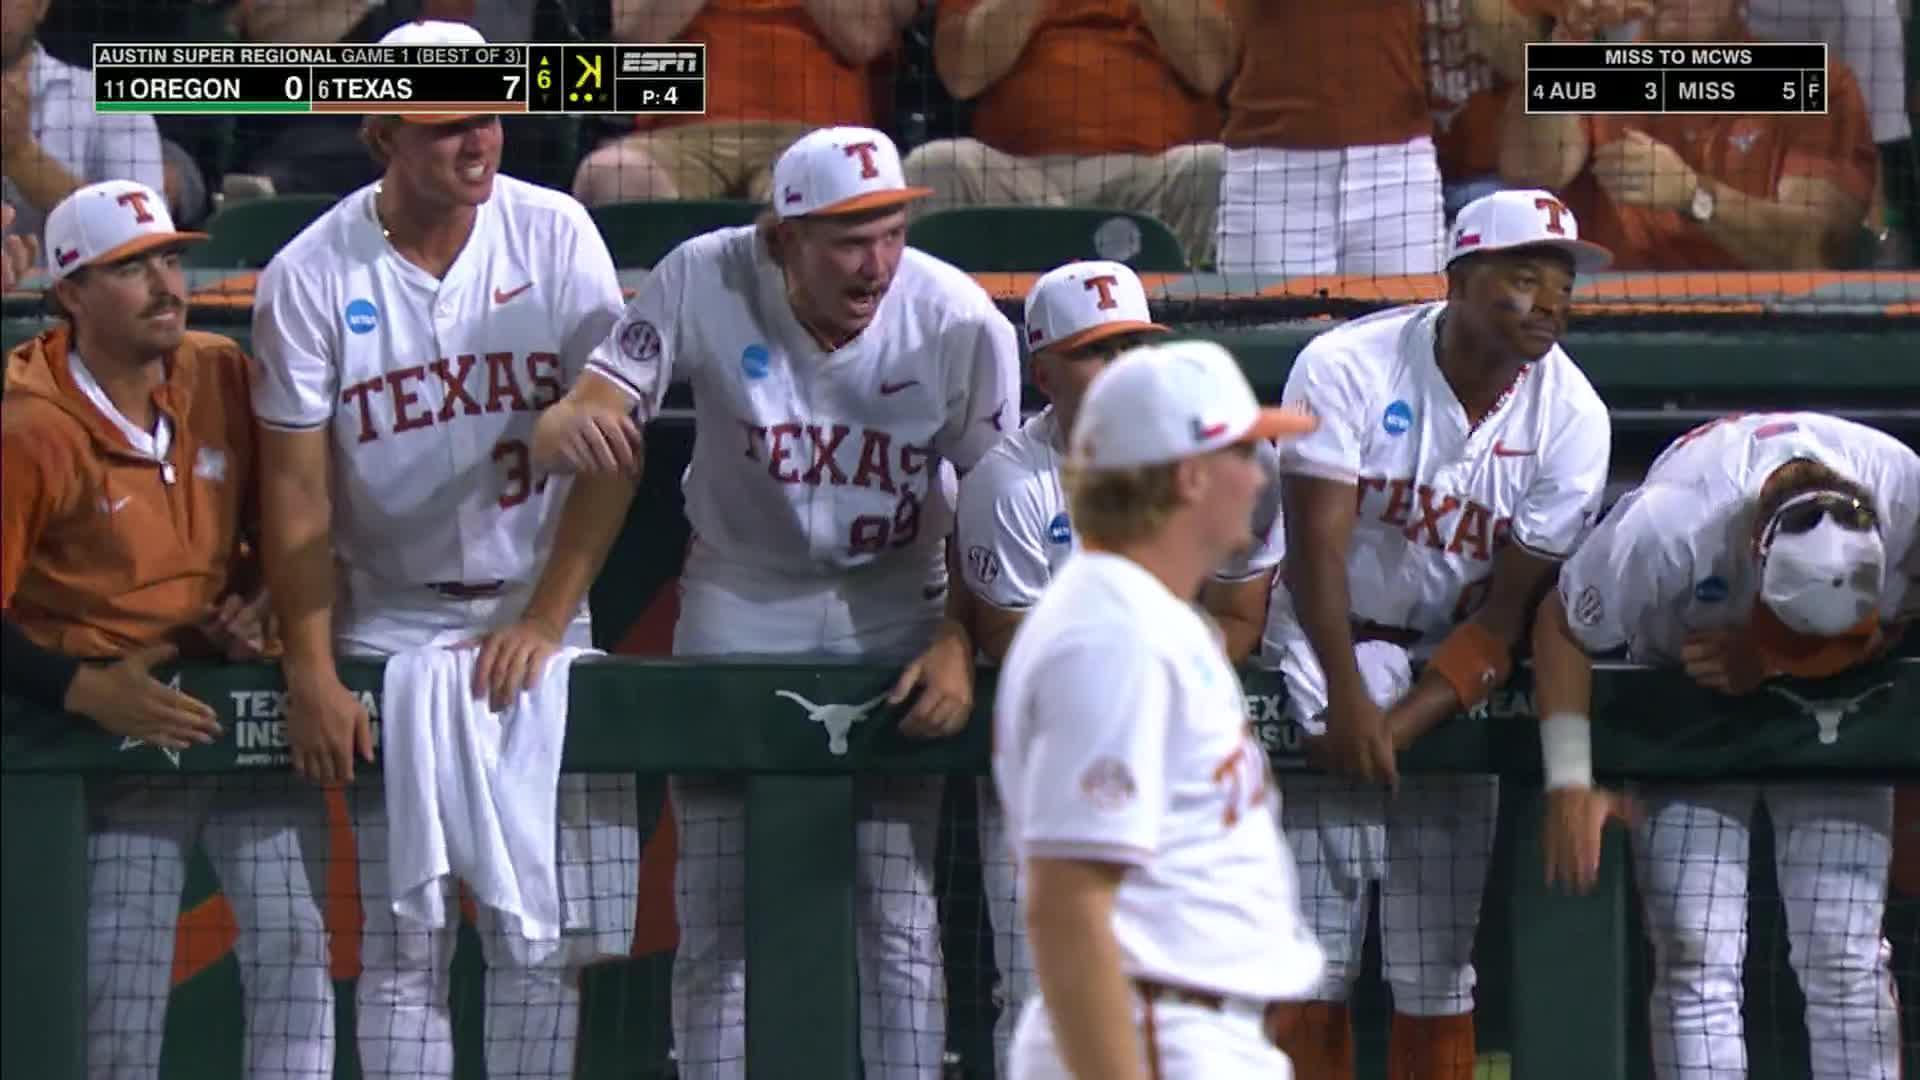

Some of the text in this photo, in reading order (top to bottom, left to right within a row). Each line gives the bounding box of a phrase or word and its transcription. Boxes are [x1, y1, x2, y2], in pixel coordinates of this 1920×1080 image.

[843, 142, 879, 179] T
[117, 191, 155, 224] T
[1534, 198, 1568, 235] T
[1083, 275, 1119, 310] T
[342, 351, 562, 443] TEXAS
[492, 439, 547, 510] 3
